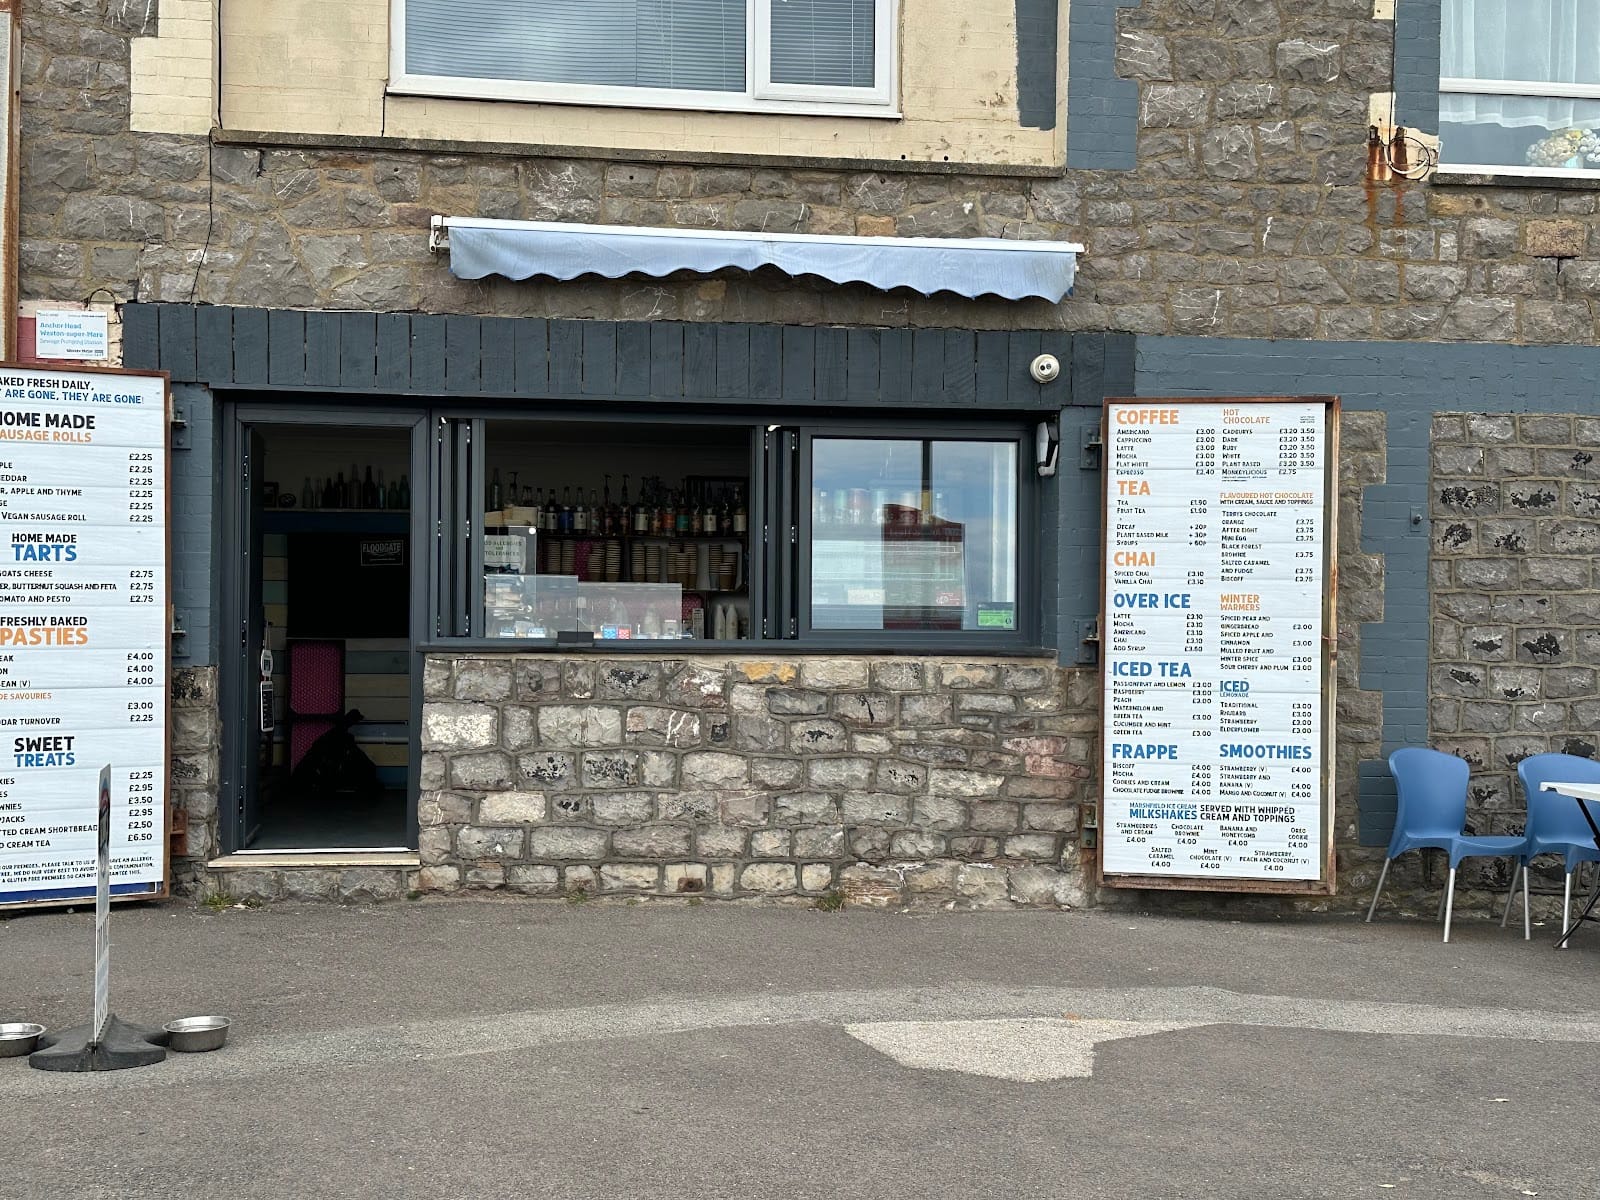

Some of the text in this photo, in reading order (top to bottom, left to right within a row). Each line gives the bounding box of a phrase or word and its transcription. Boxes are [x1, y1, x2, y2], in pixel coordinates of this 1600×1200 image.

[0, 377, 94, 391] AKED FRESH DAILY,
[5, 389, 25, 398] ARE
[28, 390, 59, 400] GONE,
[62, 392, 89, 401] THEY
[92, 394, 111, 402] ARE
[46, 414, 95, 429] MADE
[1117, 410, 1179, 424] COFFEE
[0, 429, 91, 442] AUSAGE ROLLS
[1117, 481, 1150, 495] TEA
[2, 512, 28, 520] VEGAN
[12, 534, 76, 543] HOME MADE
[12, 544, 77, 561] TARTS
[363, 542, 400, 552] FLOODGATE
[1114, 552, 1155, 566] CHAI
[1114, 593, 1190, 608] OVER ICE
[1221, 594, 1259, 603] WINTER
[1, 617, 87, 626] FRESHLY BAKED
[0, 628, 88, 645] PASTIES
[1113, 662, 1191, 677] ICED TEA
[1220, 681, 1249, 692] ICED
[14, 736, 74, 752] SWEET
[1113, 744, 1177, 759] FRAPPE
[1220, 744, 1312, 759] SMOOTHIES
[14, 753, 75, 767] TREATS
[1130, 809, 1197, 820] MILKSHAKES
[1258, 806, 1294, 814] WHIPPED
